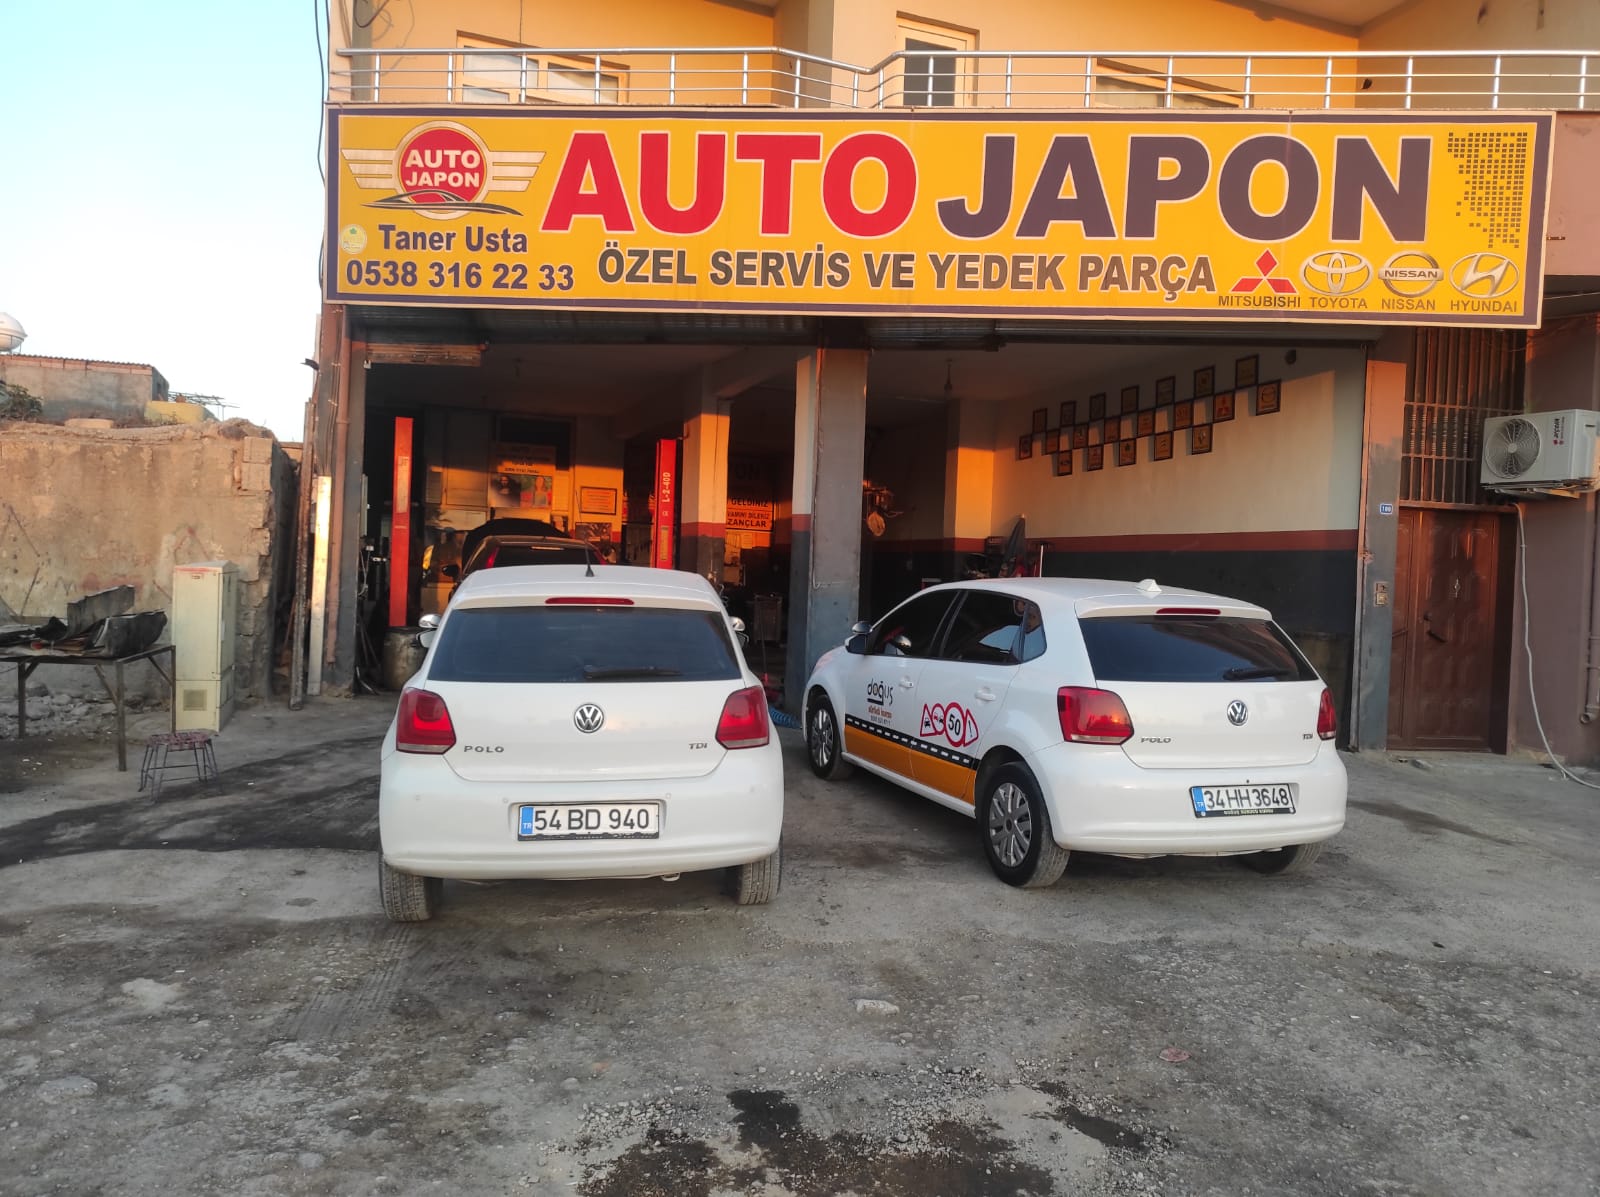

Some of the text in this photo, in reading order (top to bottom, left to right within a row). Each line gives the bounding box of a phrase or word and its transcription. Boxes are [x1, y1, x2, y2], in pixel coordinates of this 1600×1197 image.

[405, 149, 480, 169] AUTO
[405, 171, 480, 188] JAPON
[540, 131, 1433, 243] AUTO JAPON
[378, 224, 456, 252] Taner
[465, 226, 528, 253] Usta
[346, 260, 575, 291] 0538 316 22 33
[598, 241, 1216, 301] ÖZEL SERVİS VE YEDEK PARÇA
[1384, 270, 1438, 279] NISSAN
[1218, 295, 1301, 308] MITSUBISHI
[1309, 297, 1368, 310] TOYOTA
[1381, 299, 1436, 311] NISSAN
[1450, 300, 1517, 313] HYUNDAI
[948, 713, 961, 735] 50
[464, 745, 504, 753] POLO
[535, 809, 650, 830] 54 BD 940
